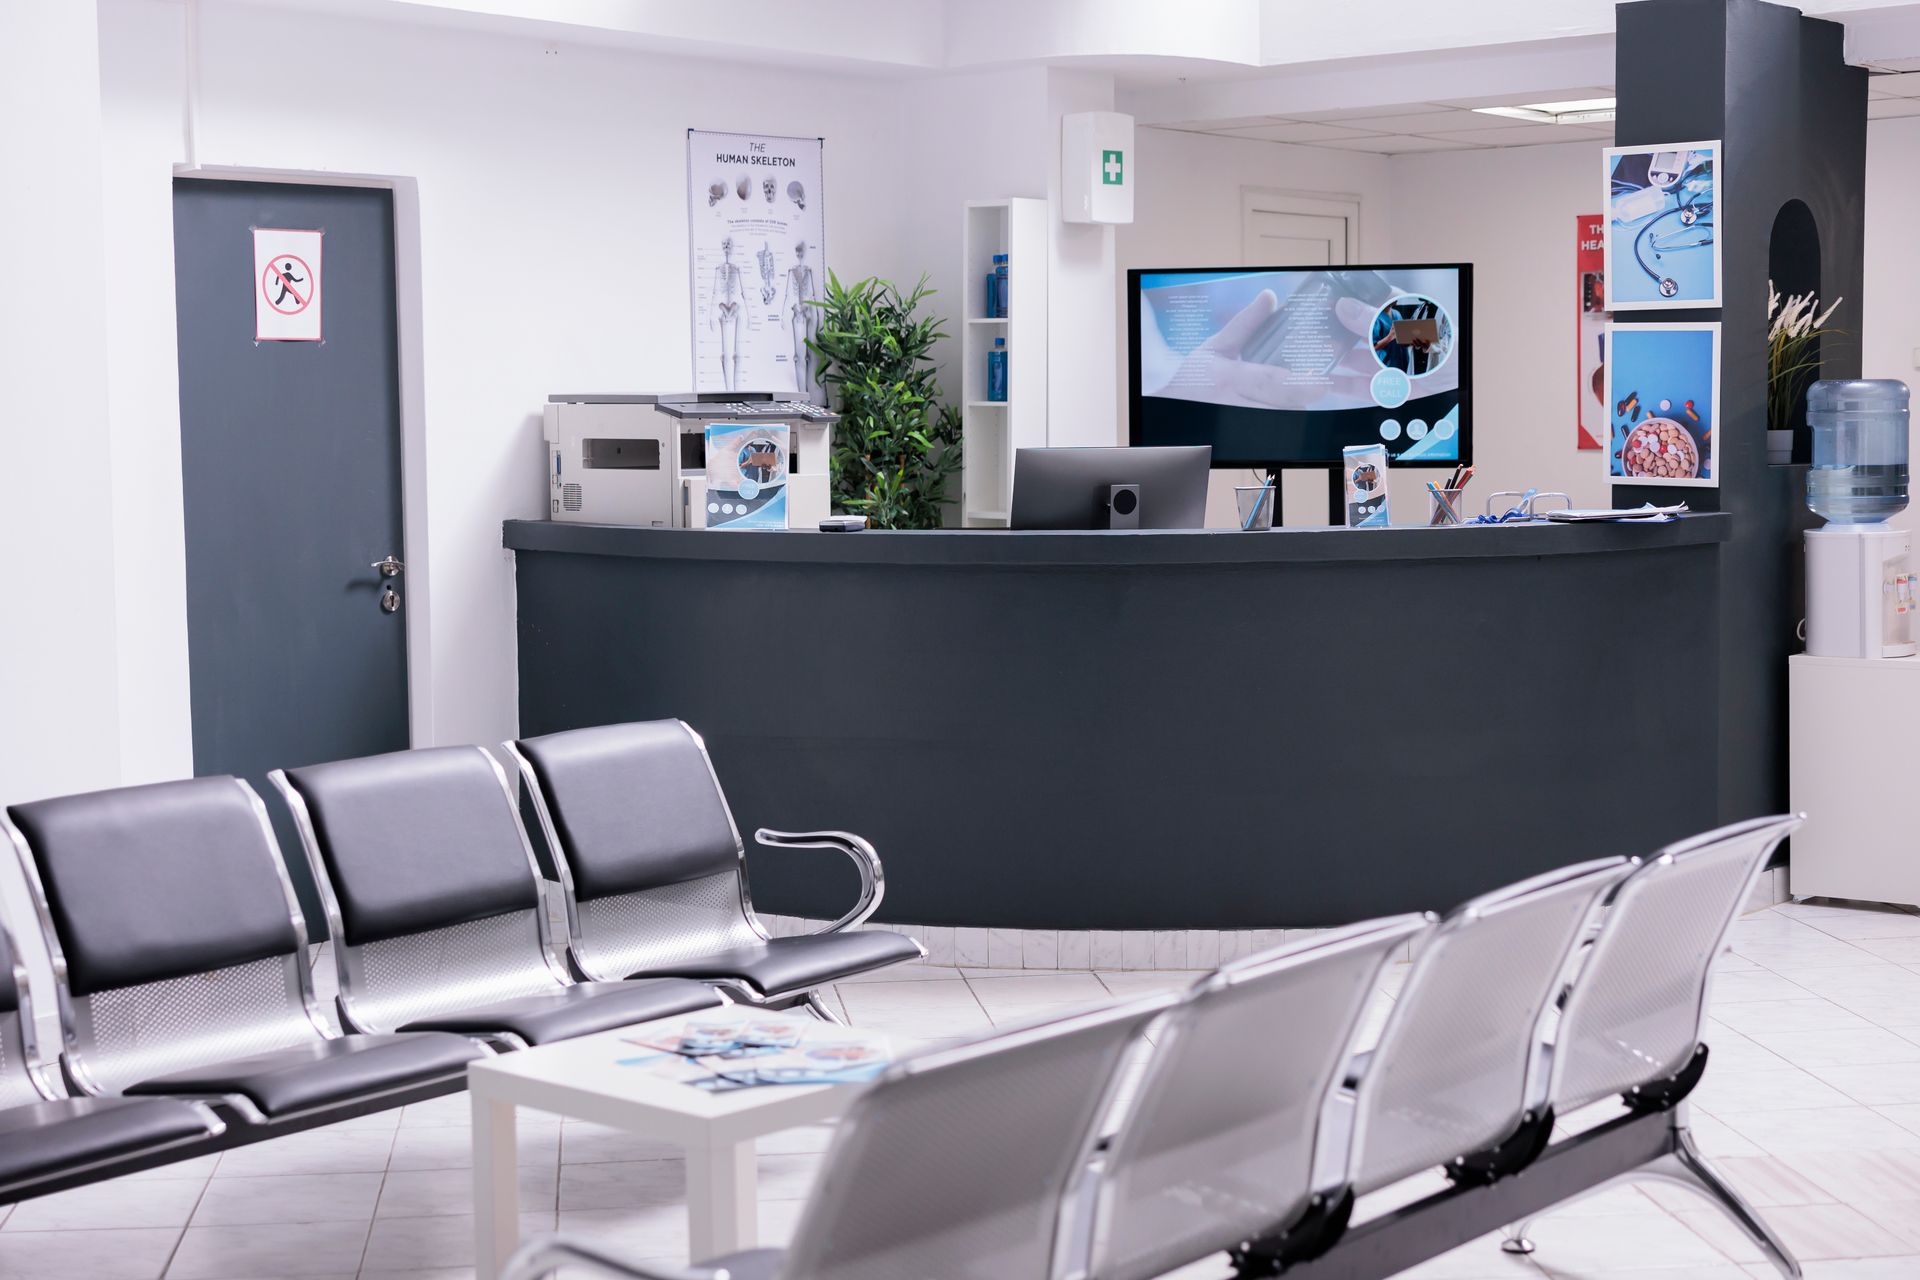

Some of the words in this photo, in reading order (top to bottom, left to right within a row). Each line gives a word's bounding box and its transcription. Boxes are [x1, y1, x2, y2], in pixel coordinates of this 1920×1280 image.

[749, 142, 766, 152] THE
[716, 154, 748, 165] HUMAN
[751, 155, 795, 167] SKELETON
[1589, 224, 1604, 234] TH
[1581, 240, 1604, 251] HEA
